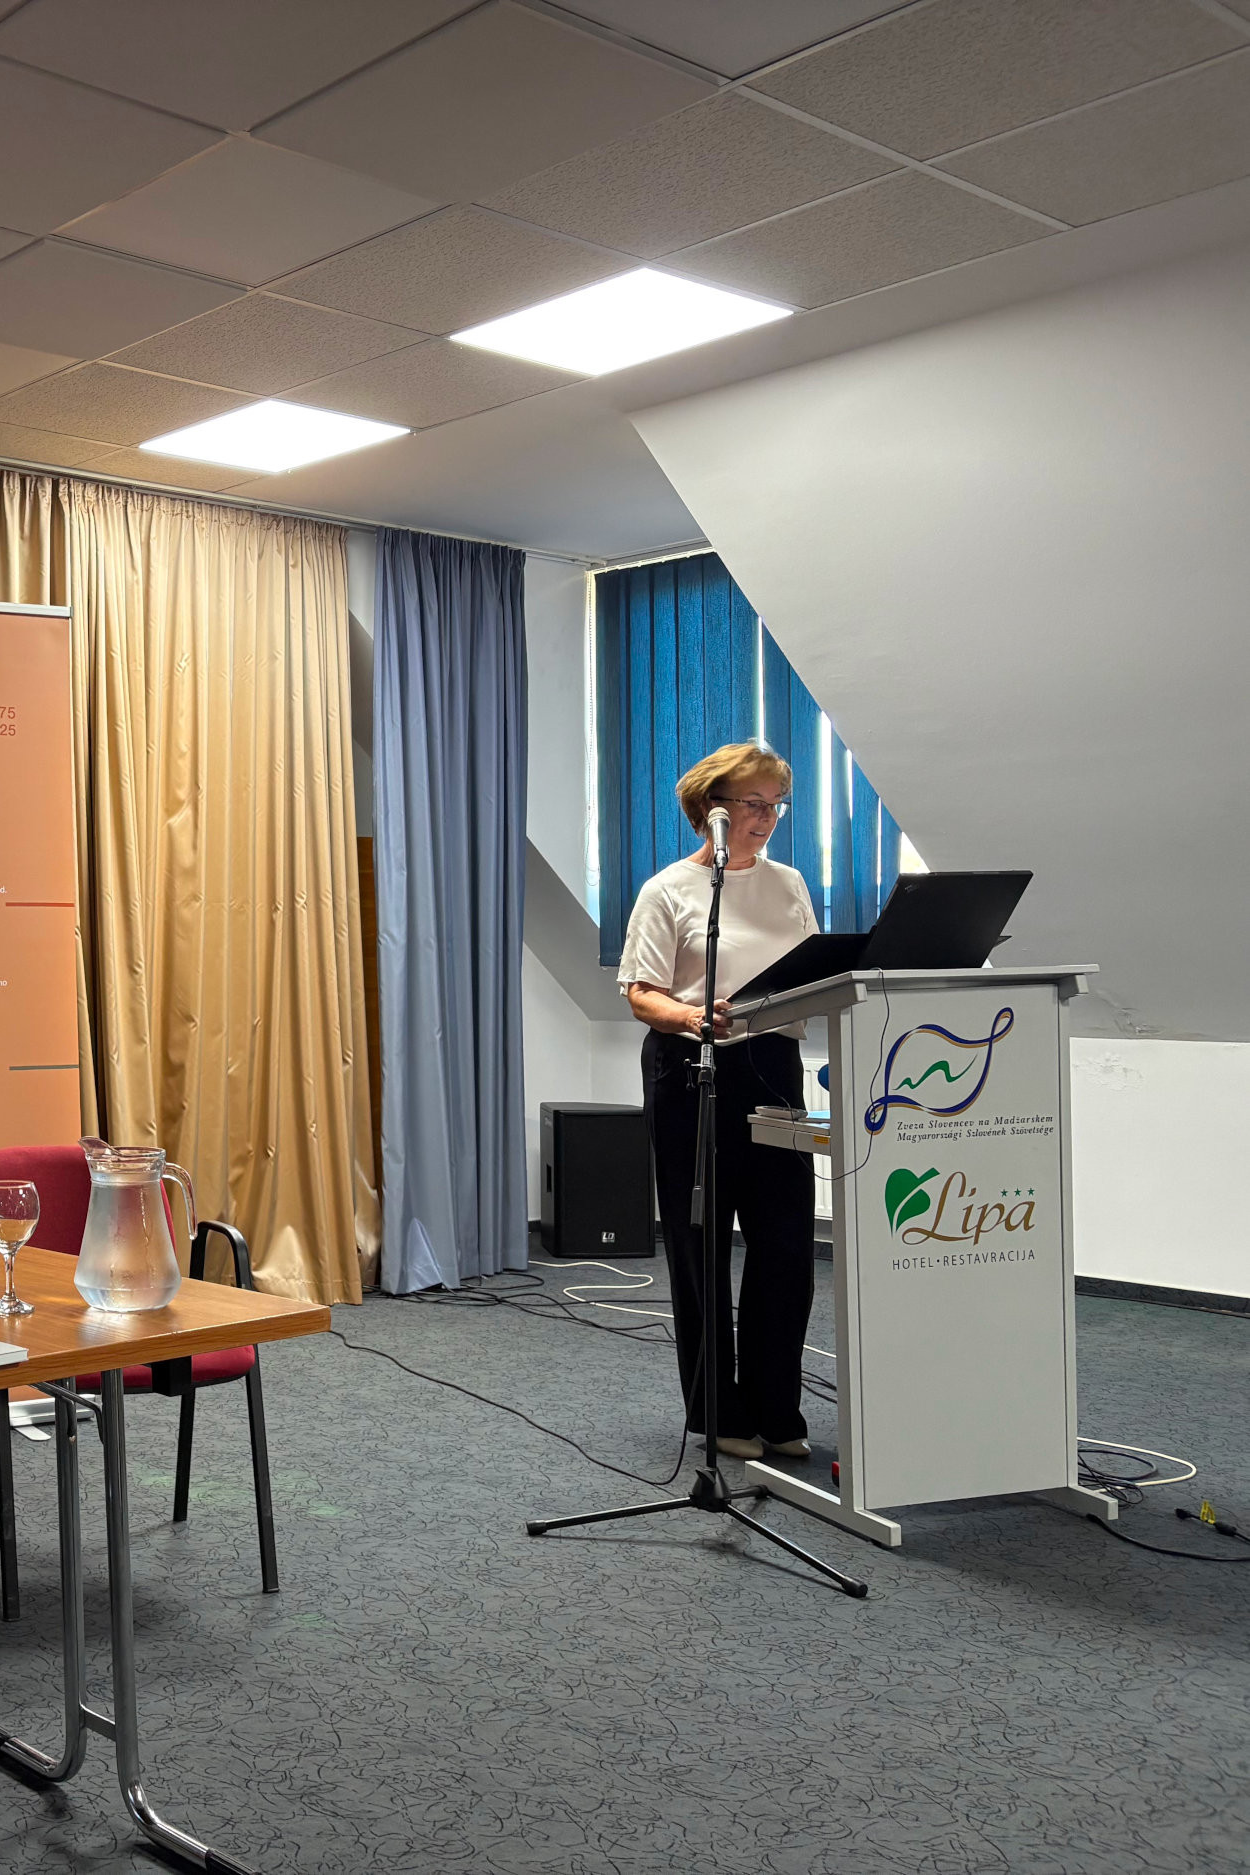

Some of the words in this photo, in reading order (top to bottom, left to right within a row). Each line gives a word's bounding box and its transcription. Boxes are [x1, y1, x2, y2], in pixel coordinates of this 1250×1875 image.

[897, 1121, 924, 1130] Zveza
[928, 1118, 975, 1129] Slovencev
[978, 1118, 990, 1126] na
[994, 1115, 1053, 1125] Madžarskem
[897, 1130, 962, 1142] Magyarországi
[966, 1127, 1006, 1138] Szlovének
[1010, 1125, 1054, 1136] Szövetsége
[902, 1171, 1035, 1246] Lipa
